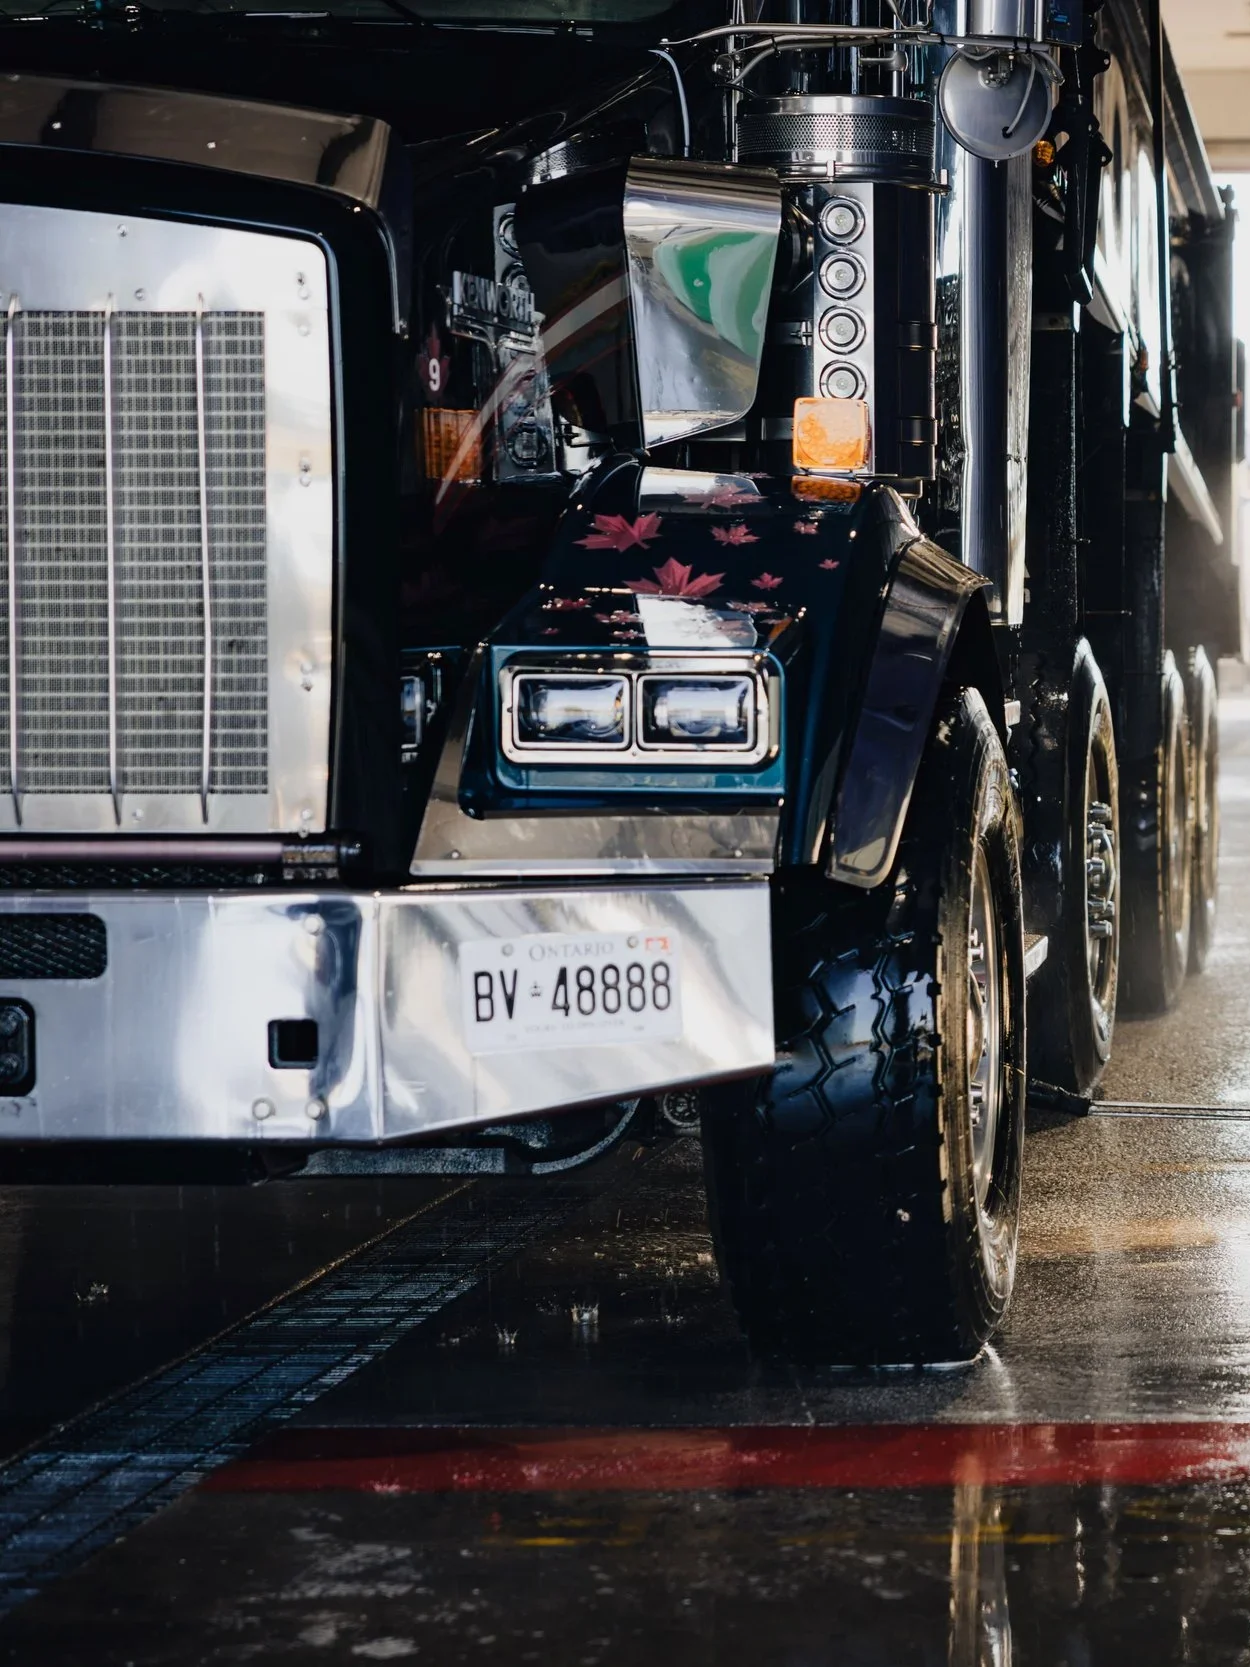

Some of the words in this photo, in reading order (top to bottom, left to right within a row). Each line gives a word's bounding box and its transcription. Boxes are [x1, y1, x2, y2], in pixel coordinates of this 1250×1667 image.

[453, 270, 535, 323] KENWORTH
[428, 358, 441, 392] 9
[529, 941, 614, 961] ONTARIO
[474, 968, 518, 1022] BV
[552, 961, 671, 1017] 48888
